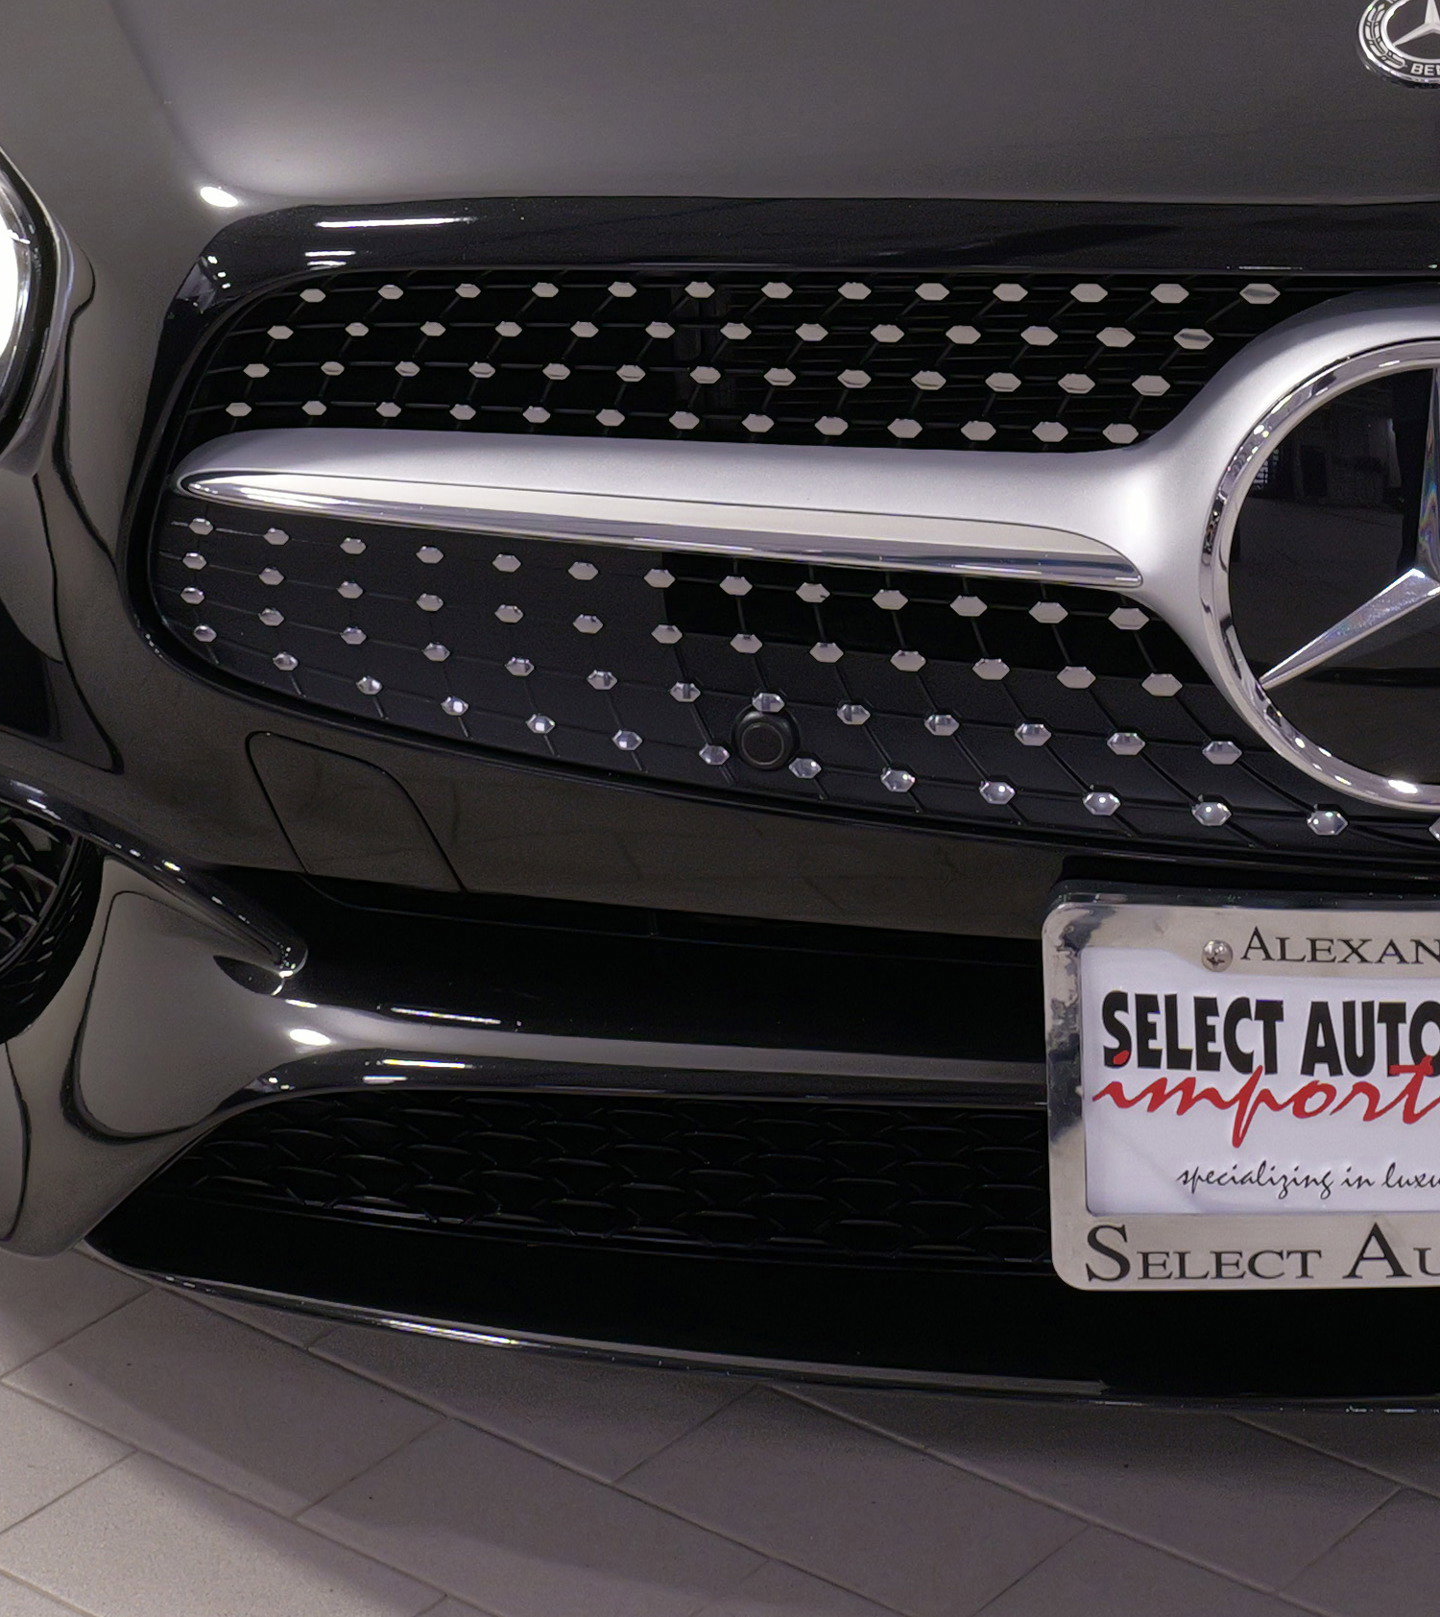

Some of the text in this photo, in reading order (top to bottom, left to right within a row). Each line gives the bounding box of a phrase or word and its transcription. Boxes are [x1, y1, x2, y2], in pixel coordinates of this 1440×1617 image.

[1102, 990, 1284, 1076] SELECT
[1175, 1160, 1334, 1199] specializing
[1341, 1166, 1375, 1189] in
[1085, 1223, 1322, 1282] SELECT
